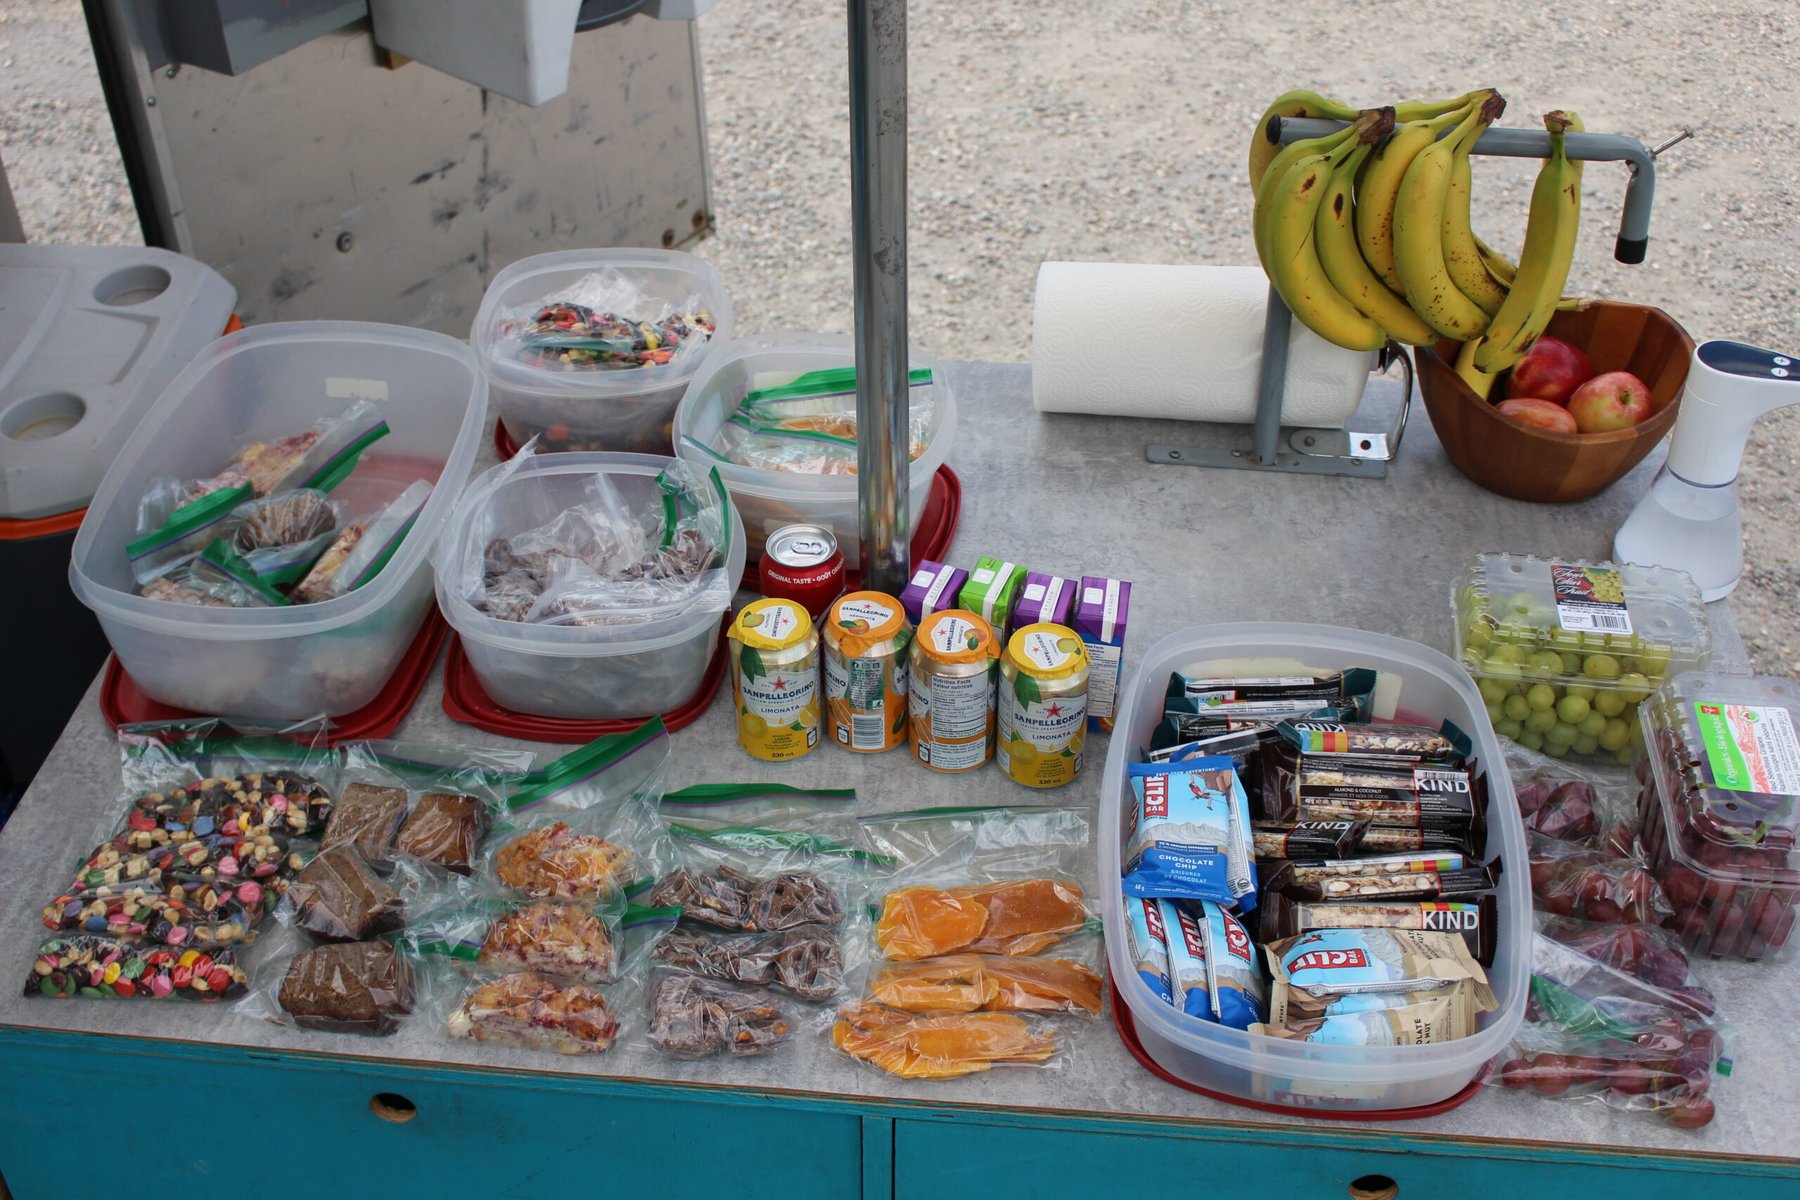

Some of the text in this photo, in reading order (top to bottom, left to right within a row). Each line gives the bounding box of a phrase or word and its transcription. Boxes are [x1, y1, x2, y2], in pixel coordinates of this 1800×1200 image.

[768, 570, 791, 584] ORIGINAL
[816, 571, 832, 582] GOÛT
[1554, 568, 1585, 578] Four
[1555, 578, 1582, 586] Star
[1556, 585, 1592, 595] Fruit
[842, 606, 889, 618] SANPELLEGRINO
[771, 606, 783, 637] SANPELLEGRINO
[946, 619, 957, 651] SANPELLEGRINO
[1035, 633, 1053, 666] SANPELLEGRINO
[932, 677, 956, 685] Nutrition
[742, 680, 814, 700] SANPELLEGRINO
[761, 705, 800, 714] LIMONATA
[1295, 722, 1347, 733] KIND
[1032, 731, 1071, 740] LIMONATA
[1722, 751, 1737, 783] Organics
[1146, 776, 1165, 805] CLIF
[1414, 778, 1470, 793] KIND
[1146, 805, 1165, 813] BAR
[1294, 821, 1350, 830] KIND
[1158, 854, 1214, 866] CHOCOLATE
[1175, 862, 1198, 870] CHIP
[1170, 869, 1201, 878] BRISURES
[1173, 875, 1207, 884] CHOCOLAT
[1422, 910, 1478, 930] KIND
[1294, 951, 1348, 970] CLIF
[1346, 950, 1359, 964] BAR
[1414, 1018, 1422, 1045] OLATE
